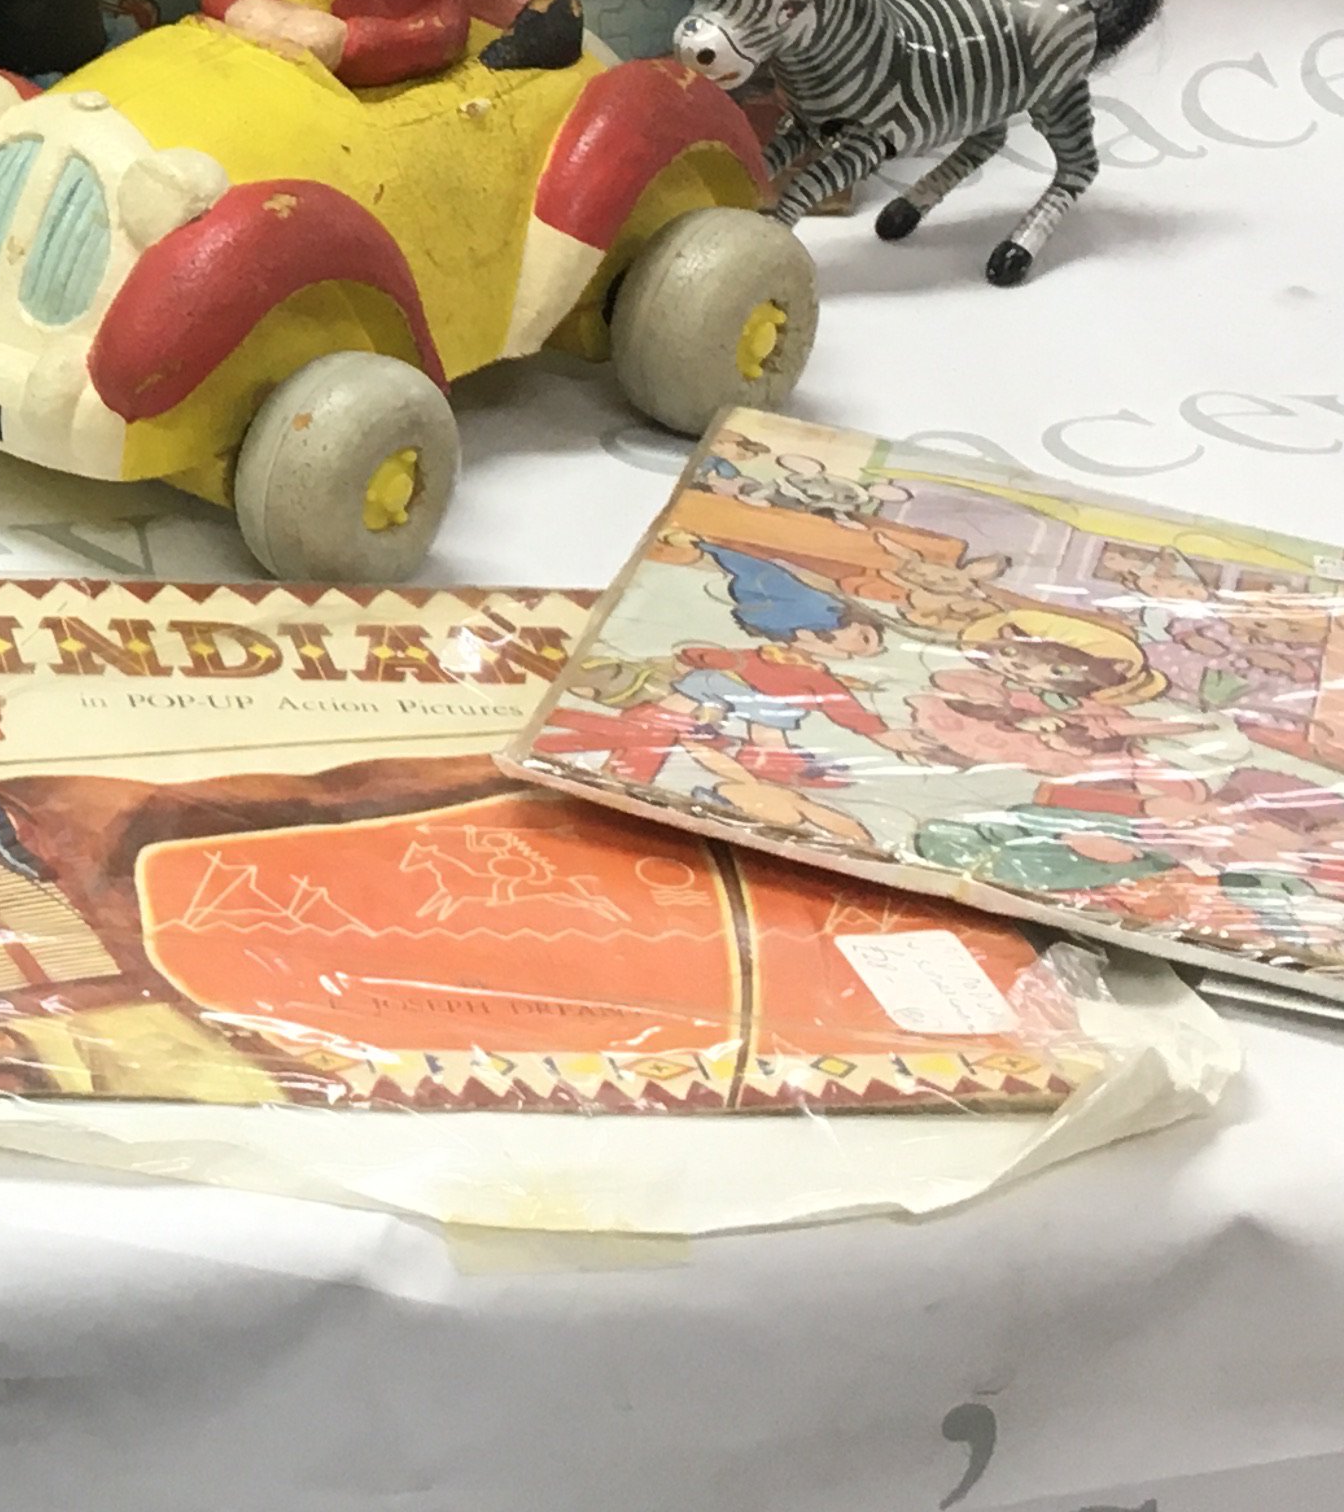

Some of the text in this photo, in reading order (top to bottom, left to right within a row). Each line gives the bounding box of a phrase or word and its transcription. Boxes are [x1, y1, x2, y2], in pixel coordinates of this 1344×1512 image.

[81, 692, 525, 718] in POP-UP Action Pictures
